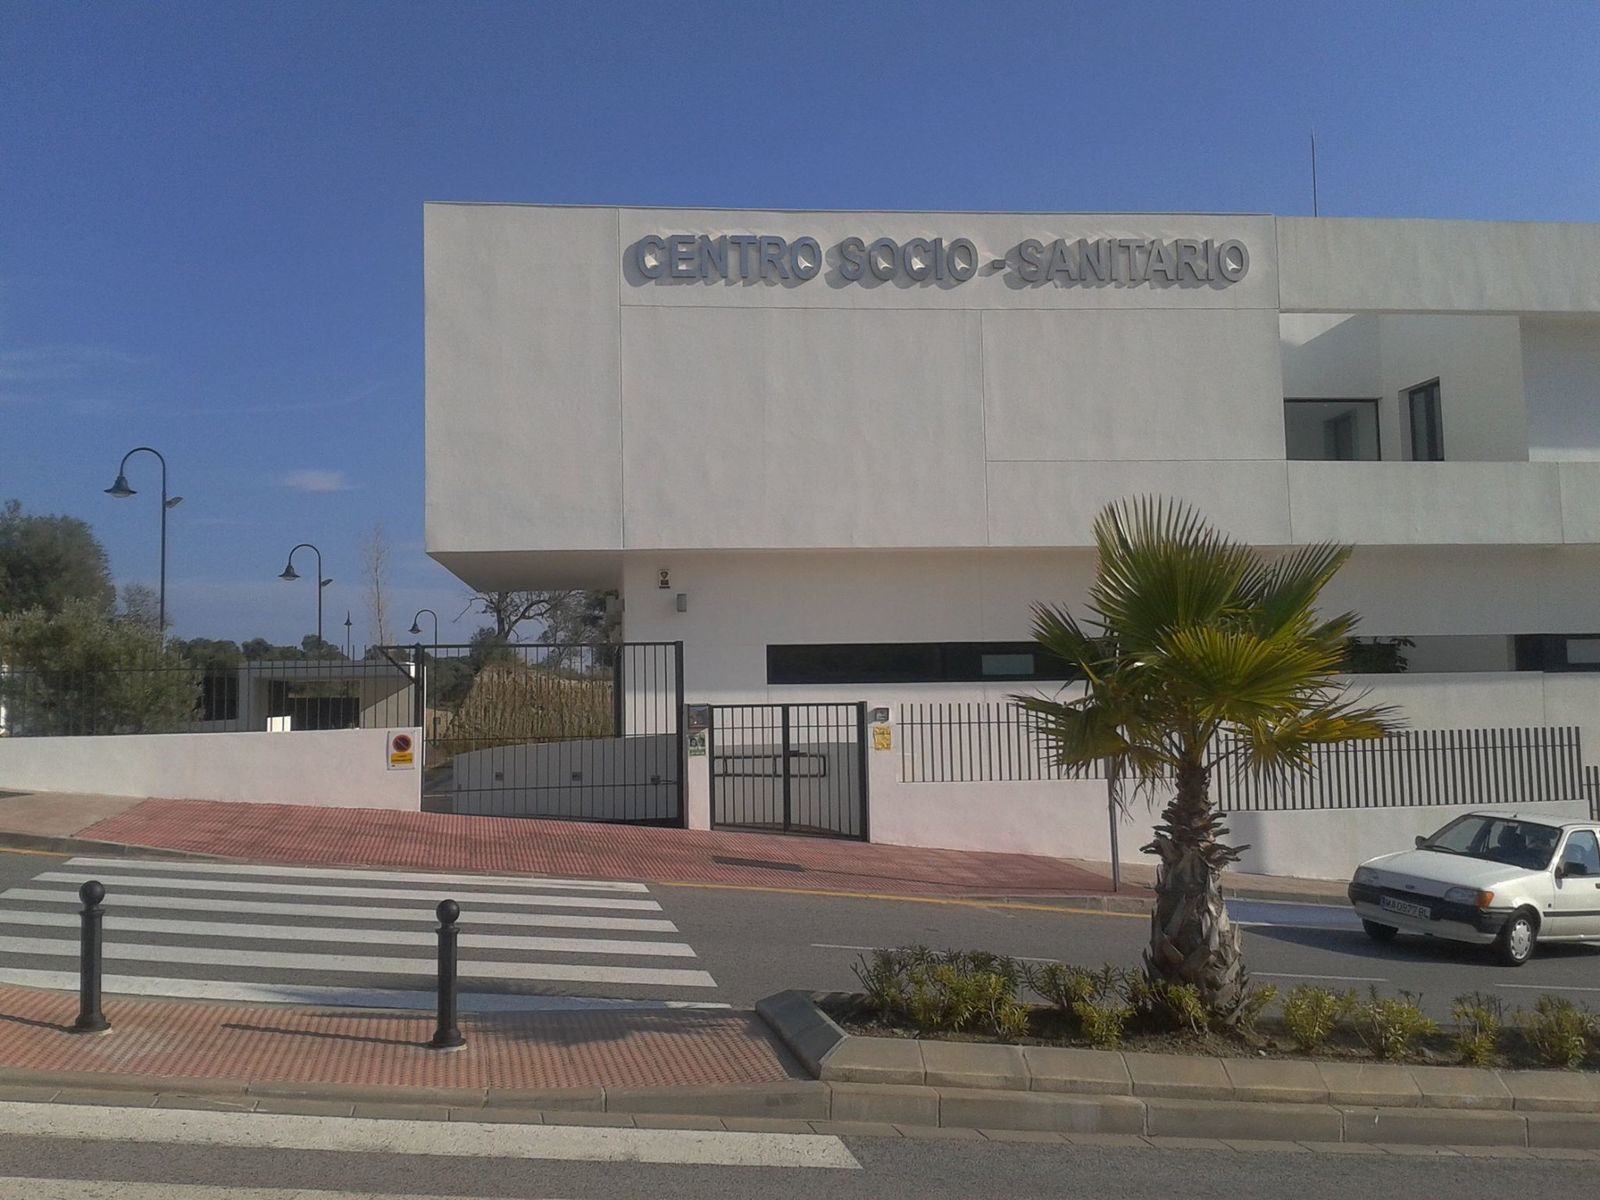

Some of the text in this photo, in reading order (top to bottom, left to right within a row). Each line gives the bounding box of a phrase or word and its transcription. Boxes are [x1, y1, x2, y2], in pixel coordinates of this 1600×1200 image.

[638, 234, 822, 280] CENTRO
[839, 237, 979, 281] SOCIO
[1018, 238, 1250, 282] SANITARIO
